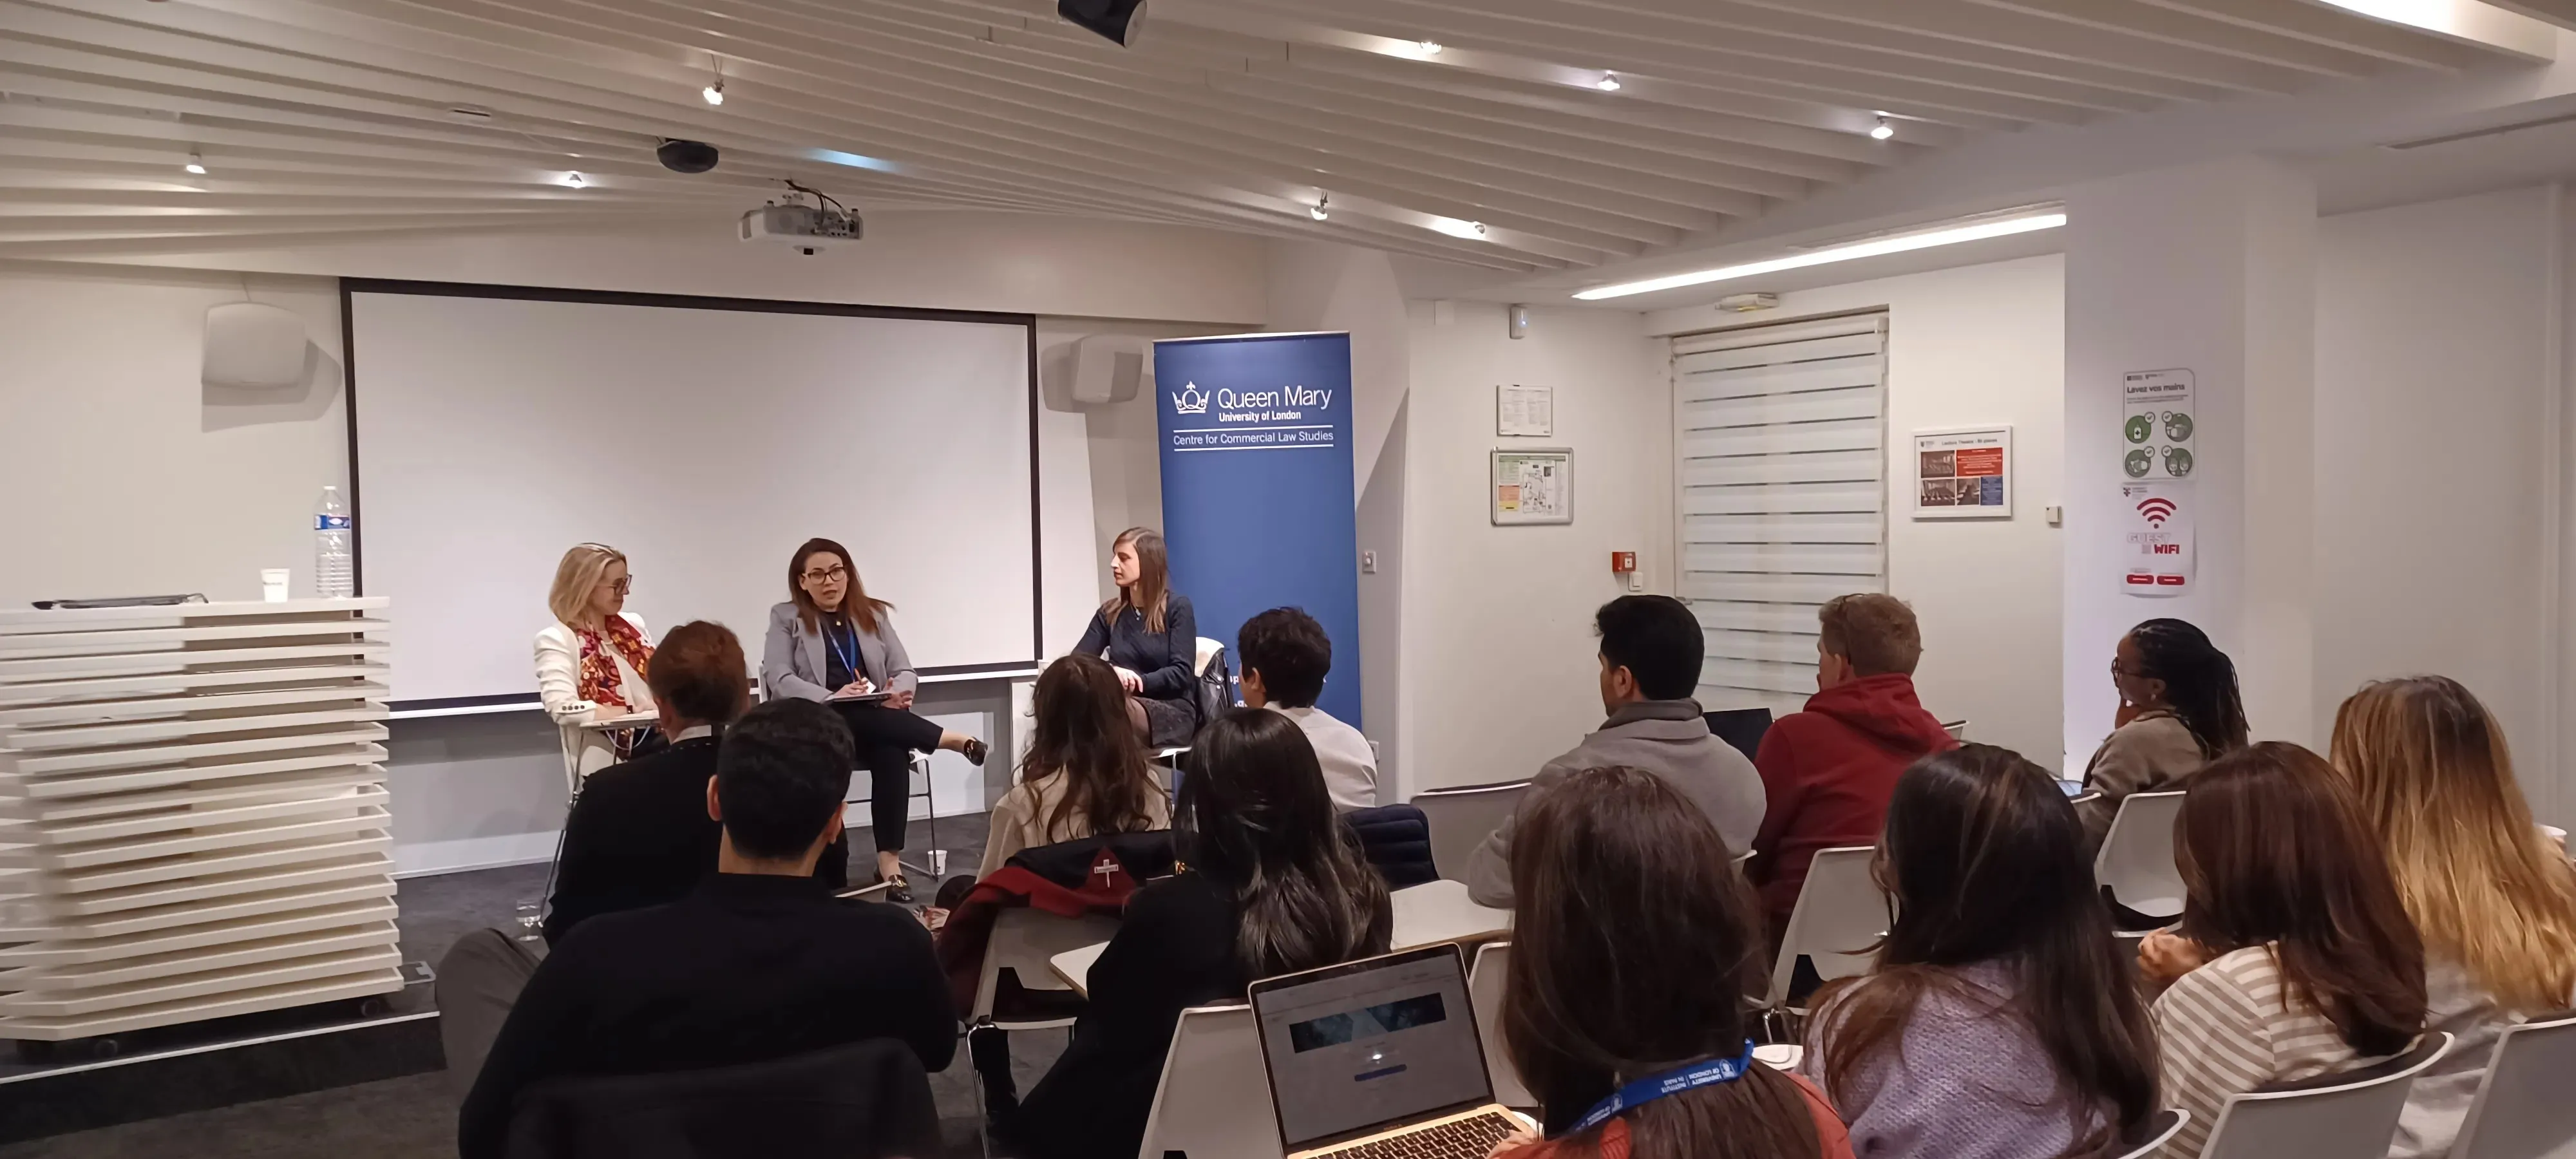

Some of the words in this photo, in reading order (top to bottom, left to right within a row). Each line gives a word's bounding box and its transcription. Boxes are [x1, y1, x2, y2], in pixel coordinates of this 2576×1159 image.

[1217, 388, 1279, 410] Queen
[1285, 386, 1332, 410] Mary
[1218, 412, 1260, 423] University
[1261, 411, 1269, 420] of
[1272, 410, 1302, 420] London
[1173, 435, 1203, 446] Centre
[1206, 434, 1218, 444] for
[1220, 433, 1275, 444] Commercial
[1278, 431, 1296, 442] Law
[1298, 430, 1334, 442] Studies
[2127, 532, 2171, 543] GUEST
[2154, 544, 2180, 554] WIFI
